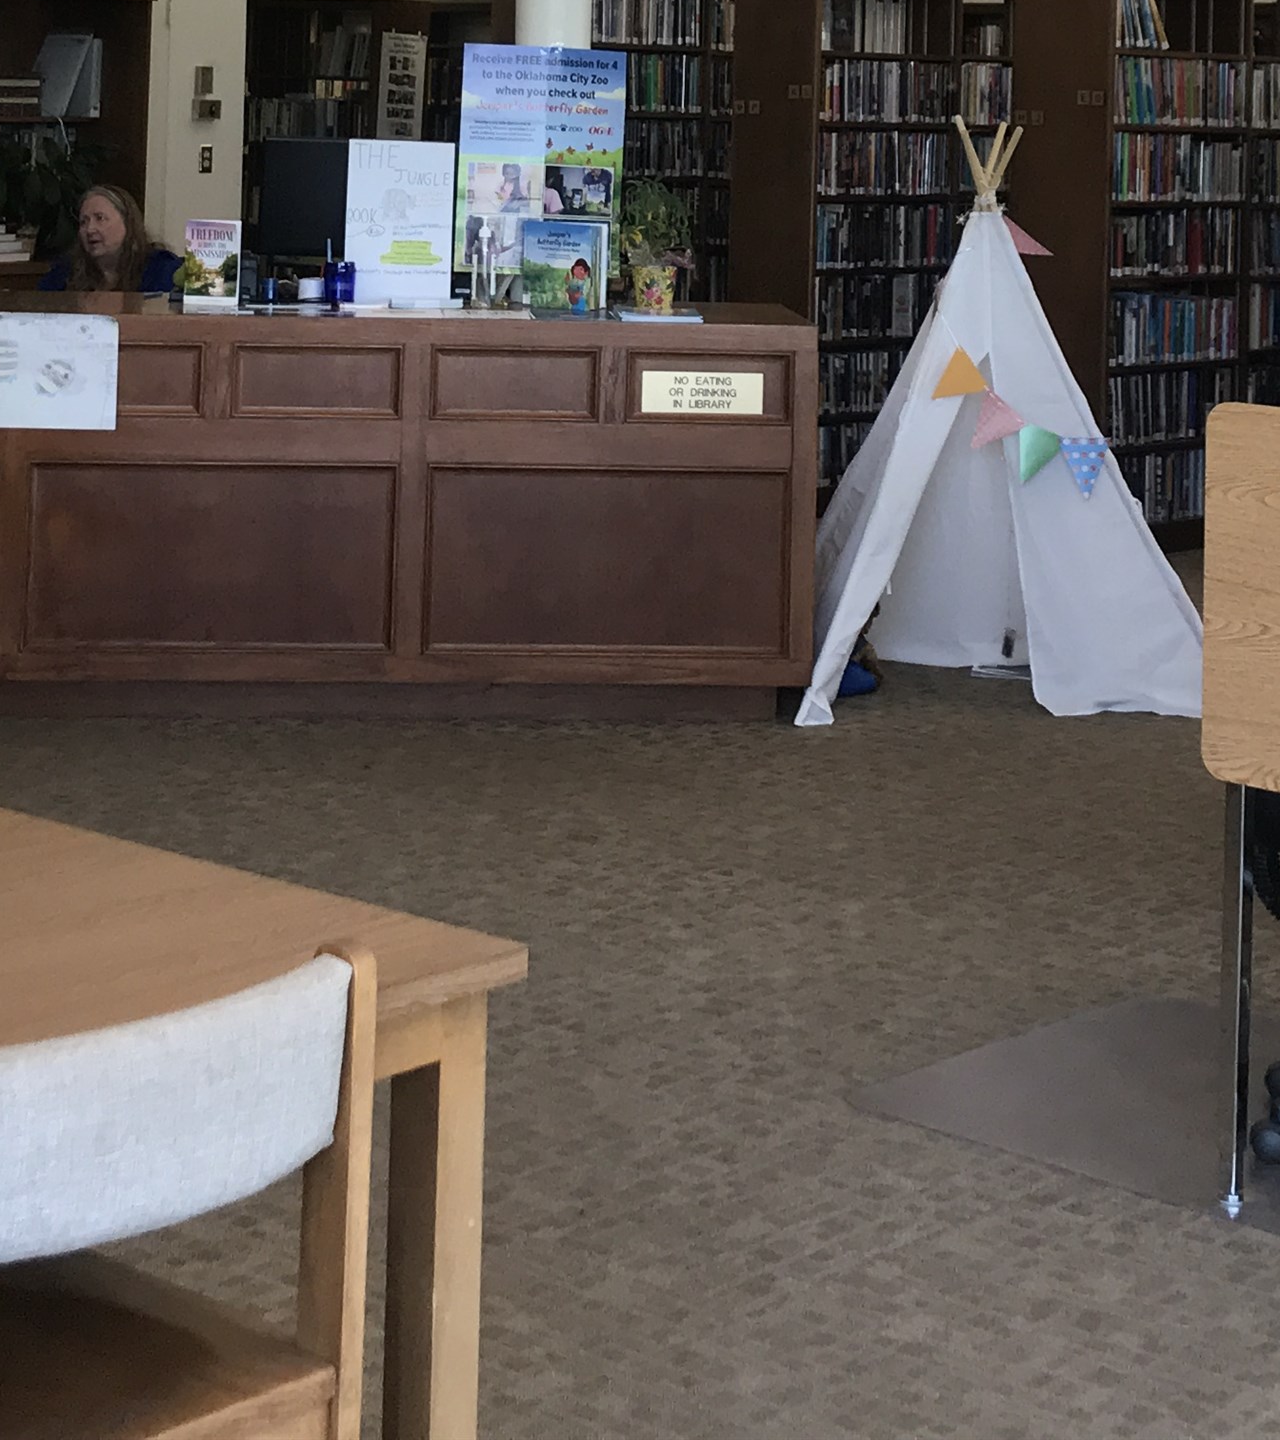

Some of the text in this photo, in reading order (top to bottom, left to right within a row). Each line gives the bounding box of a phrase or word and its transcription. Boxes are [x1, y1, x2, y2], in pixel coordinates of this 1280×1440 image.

[472, 53, 619, 70] Receive FREE admission for 4
[482, 69, 609, 86] to the Oklahoma City Zoo
[495, 86, 596, 100] when you check out
[575, 104, 609, 116] Garden
[354, 141, 401, 169] THE
[393, 168, 451, 187] JUNGLE
[191, 228, 233, 242] FREEDOM
[562, 239, 581, 247] Garden
[674, 376, 732, 386] NO EATING
[669, 388, 737, 398] OR DRINKING
[673, 399, 732, 409] IN LIBRARY
